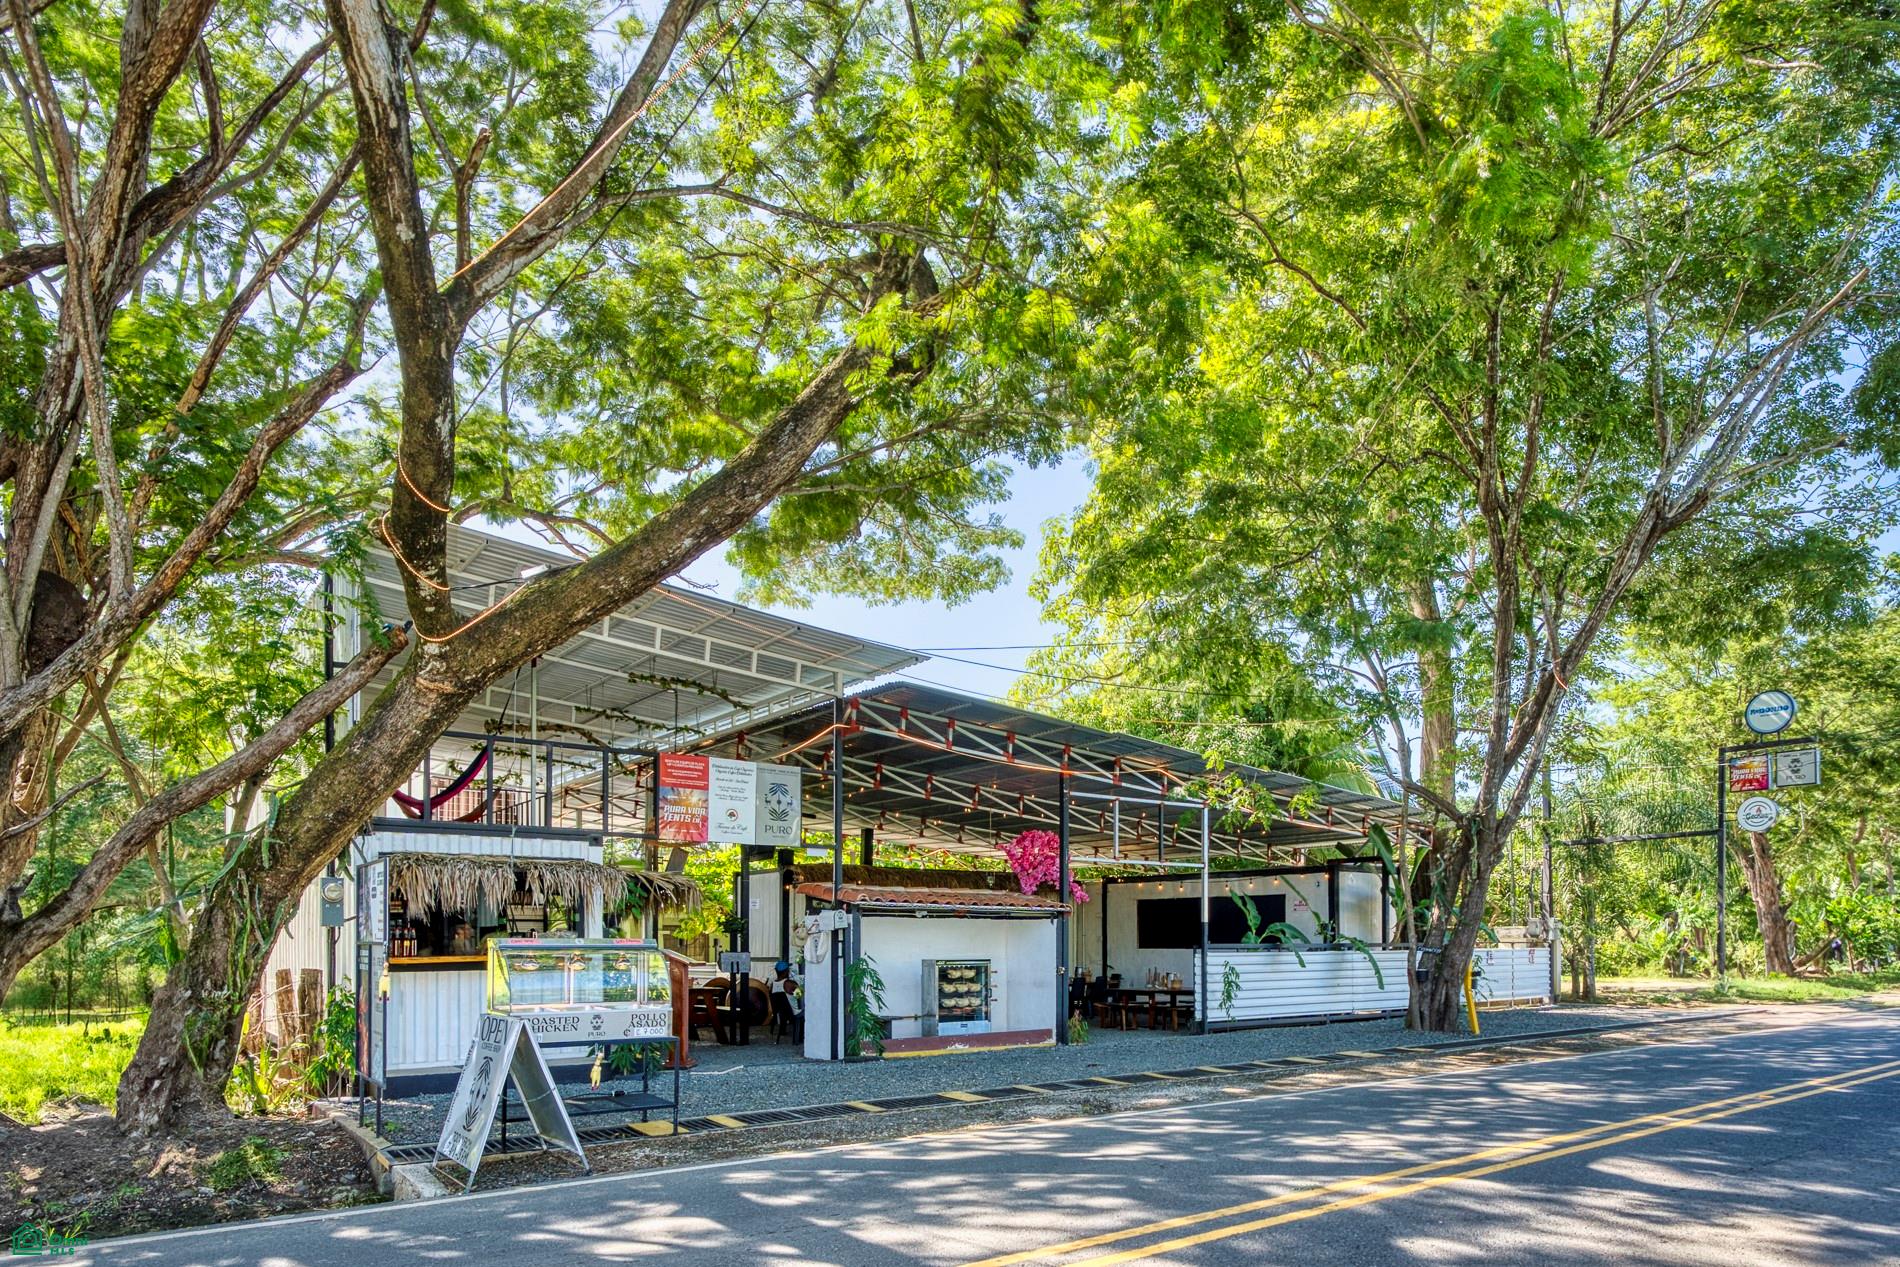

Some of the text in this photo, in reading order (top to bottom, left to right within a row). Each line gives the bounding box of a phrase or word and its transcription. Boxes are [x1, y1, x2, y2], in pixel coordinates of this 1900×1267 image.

[664, 813, 692, 823] TENTS
[764, 824, 793, 835] PURO
[631, 1012, 667, 1021] POLLO
[628, 1019, 667, 1028] ASADO
[481, 1016, 512, 1045] OPEN
